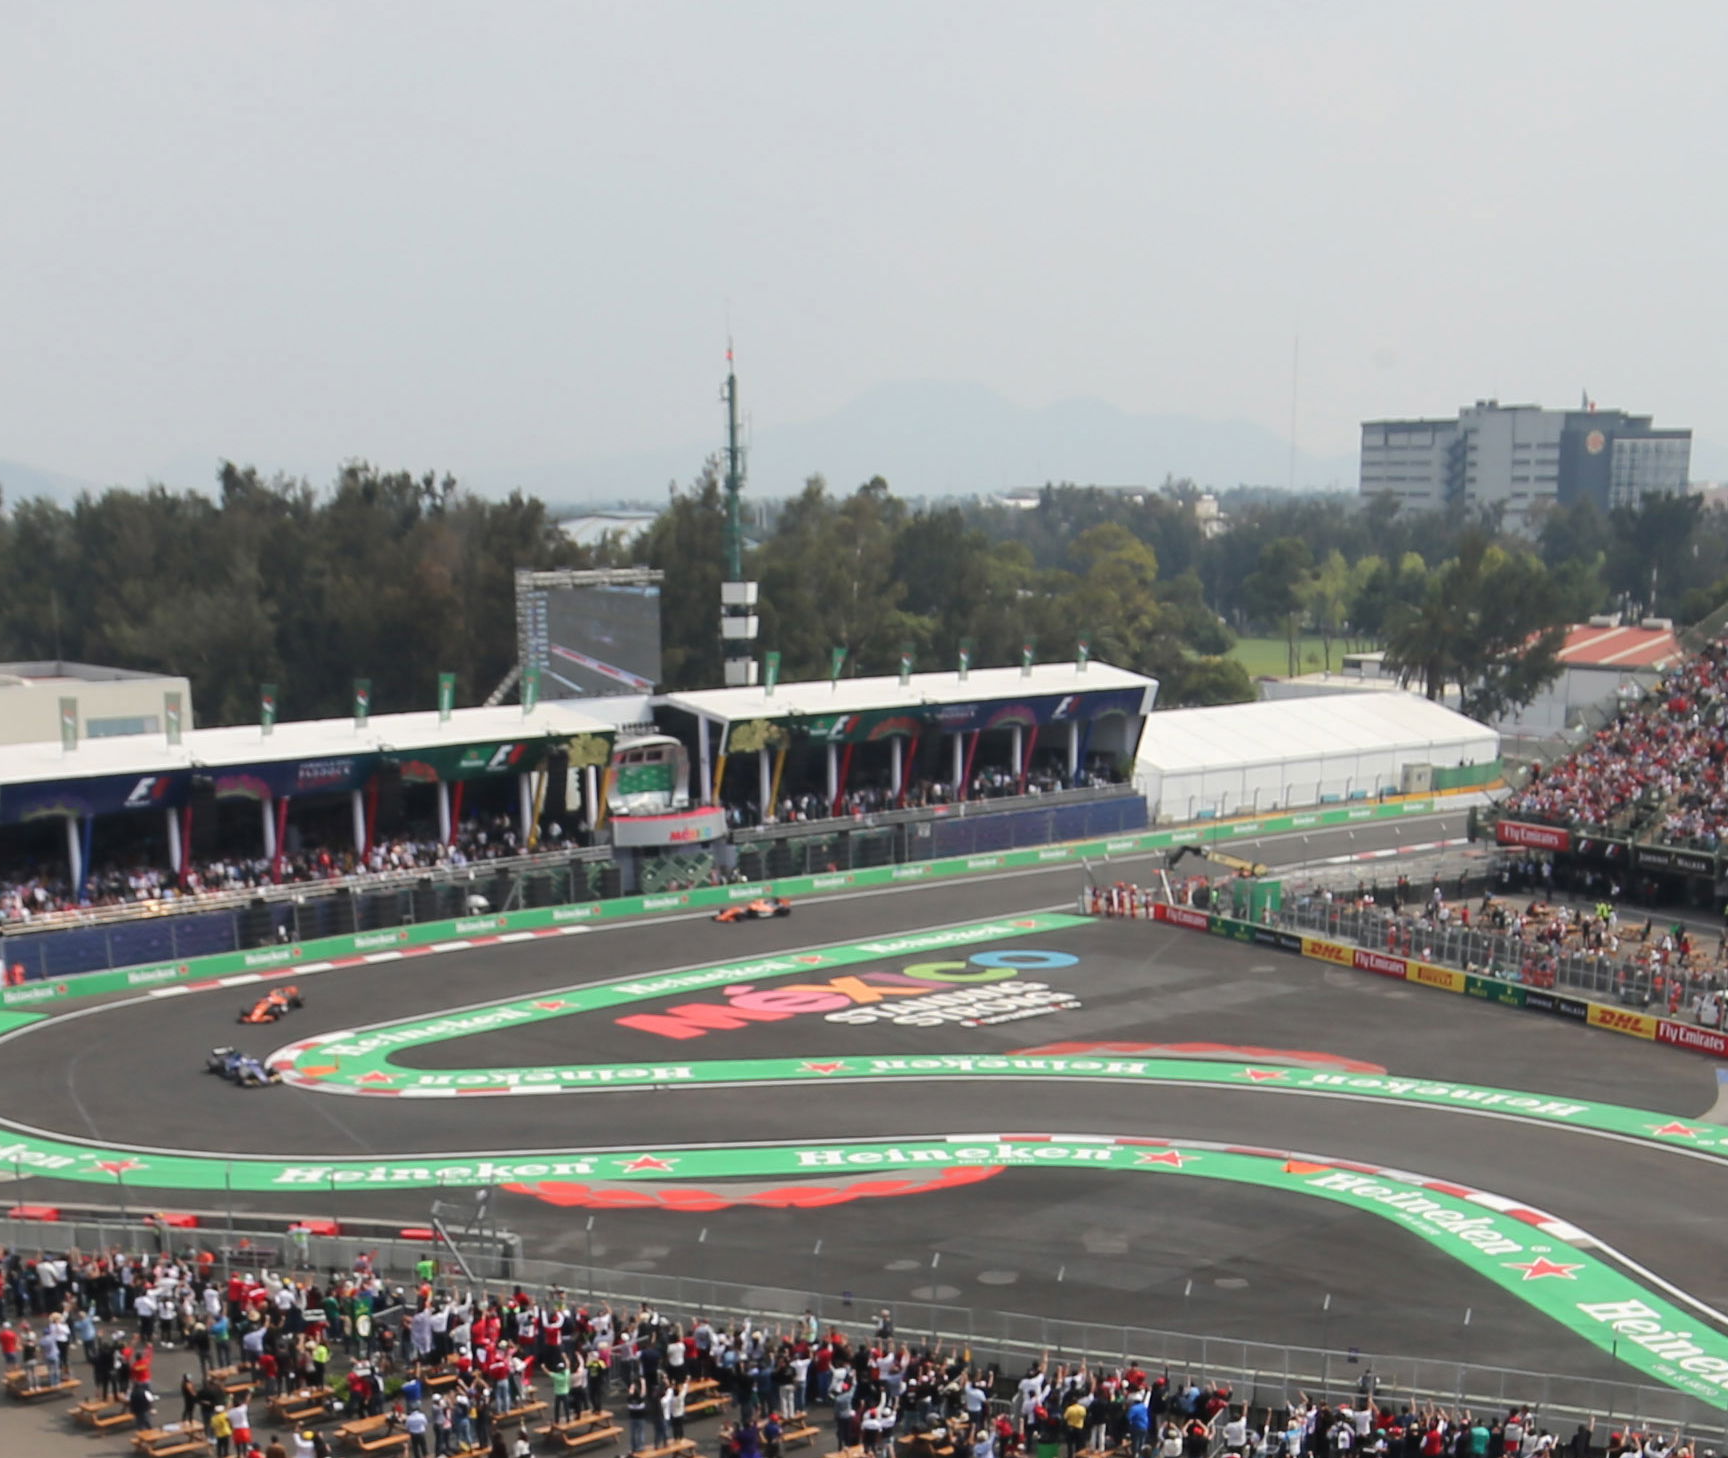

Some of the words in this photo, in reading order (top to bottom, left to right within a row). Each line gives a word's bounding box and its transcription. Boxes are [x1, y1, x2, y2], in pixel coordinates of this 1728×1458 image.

[355, 933, 397, 948] Heineken
[245, 949, 290, 966] Heineken
[1355, 951, 1370, 969] Fly
[1371, 954, 1405, 975] Emirates
[128, 966, 176, 984] Heineken
[4, 986, 55, 1004] Heineken
[1599, 1009, 1644, 1032] DHL
[1659, 1023, 1677, 1041] Fly
[1679, 1029, 1725, 1051] Emirates
[419, 1065, 695, 1086] Heineken
[871, 1057, 1151, 1075] Heineken
[1310, 1073, 1591, 1117] Heineken
[794, 1144, 1114, 1167] Heineken
[272, 1161, 595, 1185] Heineken
[1304, 1173, 1524, 1256] Heineken
